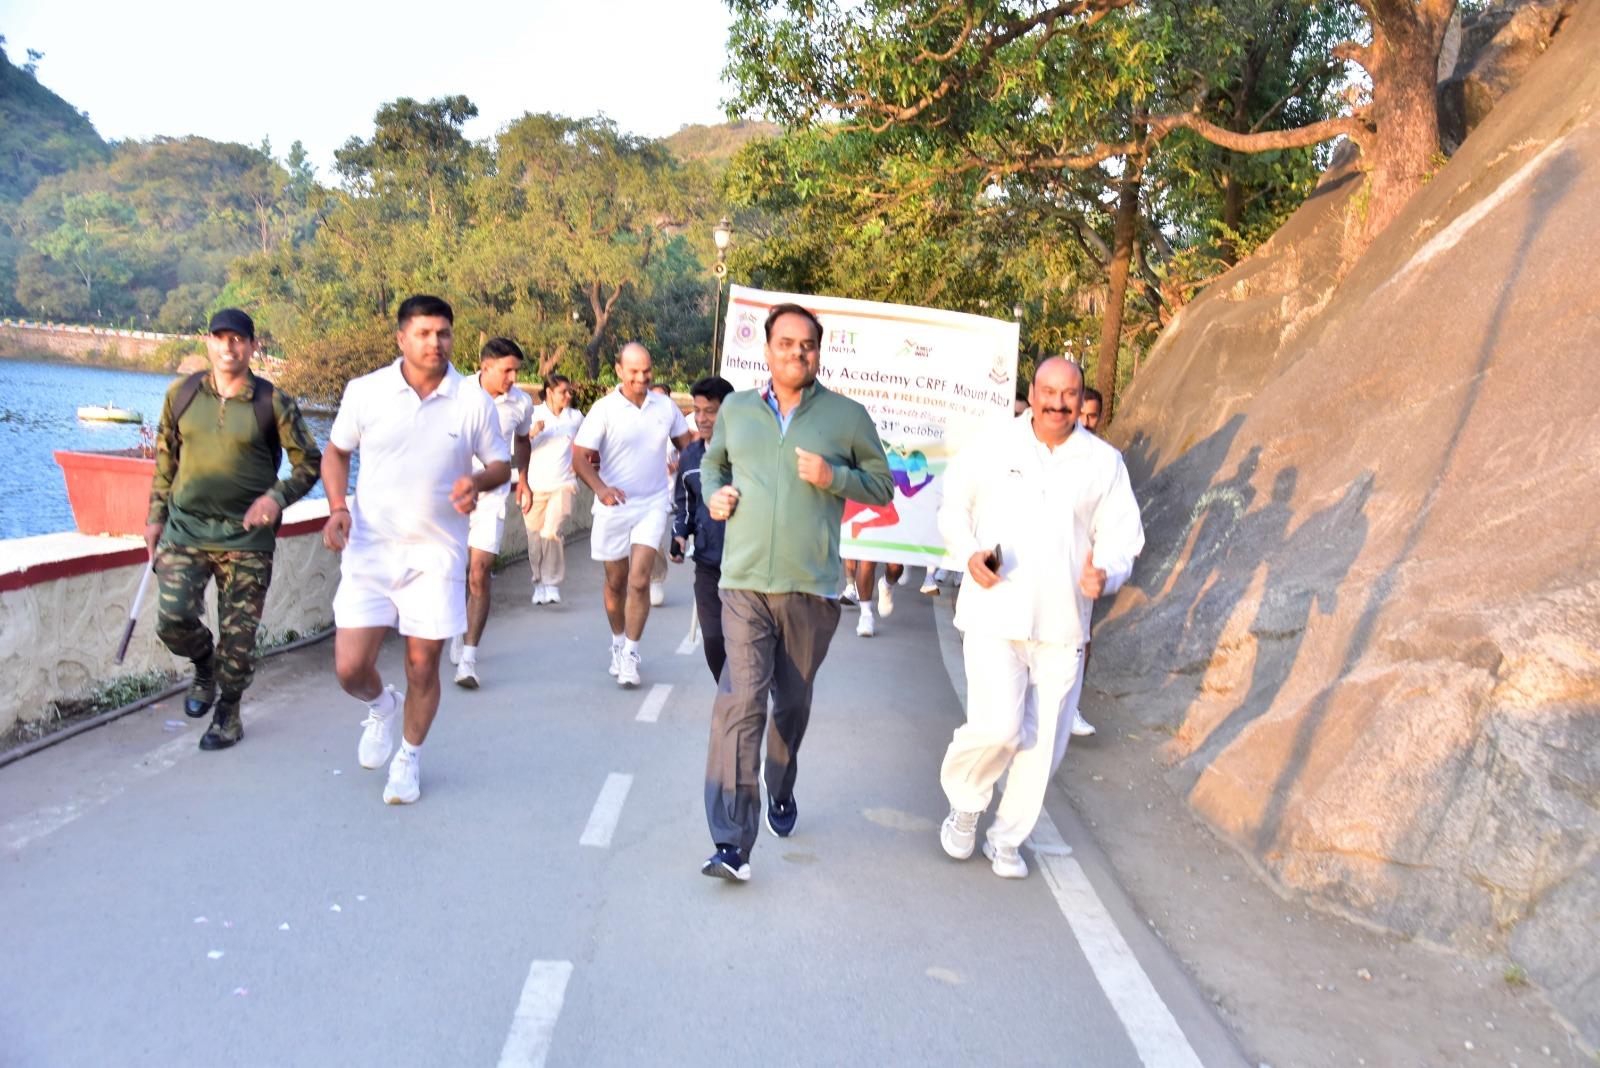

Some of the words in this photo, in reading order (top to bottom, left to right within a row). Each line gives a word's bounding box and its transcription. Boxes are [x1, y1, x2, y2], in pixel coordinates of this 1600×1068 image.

[828, 345, 856, 355] INDIA
[726, 354, 770, 372] Interna
[840, 367, 911, 388] Academy
[915, 376, 947, 391] CRPF
[953, 384, 988, 402] Mount
[990, 391, 1010, 408] Abu
[893, 392, 946, 408] FREEDOM
[903, 423, 944, 440] october
